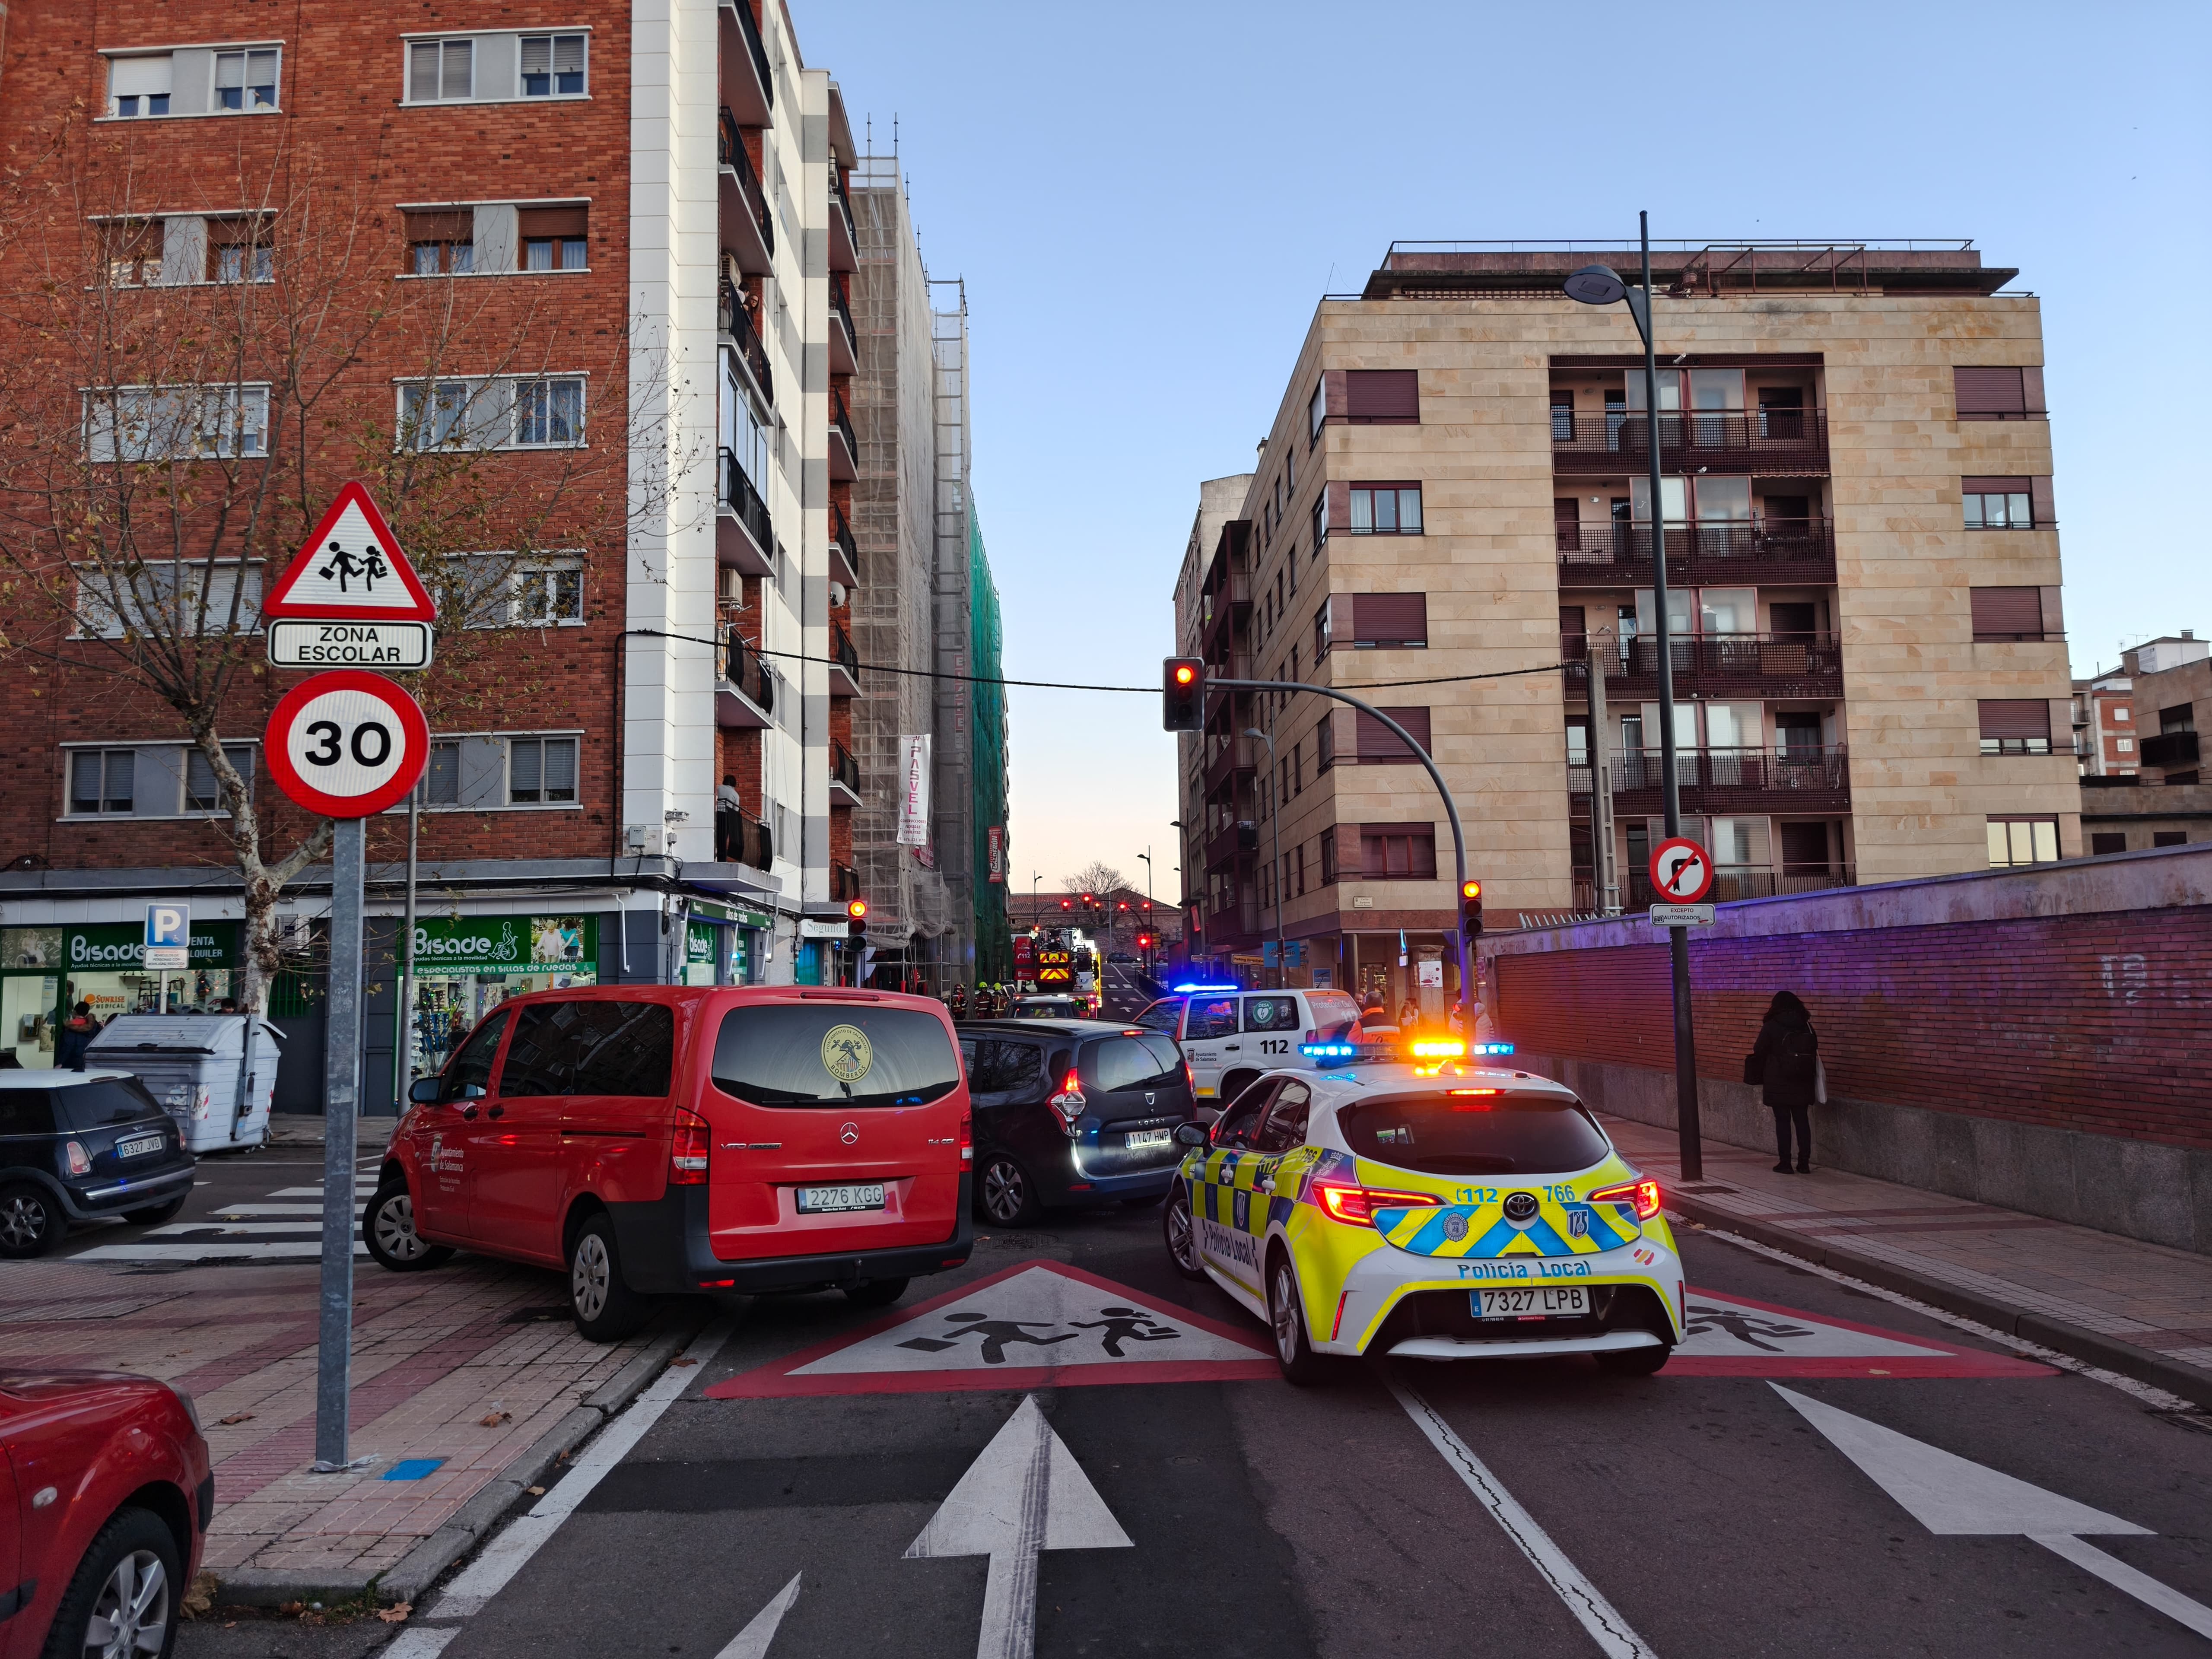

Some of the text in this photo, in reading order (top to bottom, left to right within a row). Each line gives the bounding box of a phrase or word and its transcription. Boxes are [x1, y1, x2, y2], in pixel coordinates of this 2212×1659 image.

[320, 627, 379, 643] ZONA
[298, 645, 400, 662] ESCOLAR
[305, 720, 391, 766] 30
[155, 909, 181, 942] P
[71, 935, 145, 962] Bisade
[190, 936, 215, 946] ENTA
[414, 928, 491, 954] Bisade
[190, 949, 222, 958] LQUILER
[1311, 1000, 1353, 1009] Protección Civil
[826, 1029, 846, 1053] AYUNTAMIENTO
[852, 1032, 868, 1054] SALAMANCA
[1260, 1040, 1288, 1054] 112
[830, 1064, 866, 1078] BOMBEROS
[1138, 1118, 1165, 1126] LODGY
[1132, 1130, 1169, 1144] 1147 HMP
[124, 1141, 143, 1154] 6327
[810, 1189, 849, 1206] 2276
[854, 1187, 881, 1203] KGG
[1462, 1188, 1498, 1203] 112
[1542, 1185, 1575, 1202] 766
[1208, 1224, 1252, 1267] Policía Local
[1457, 1260, 1592, 1279] Policía Local
[1484, 1290, 1535, 1313] 7327
[1543, 1289, 1583, 1310] LPB
